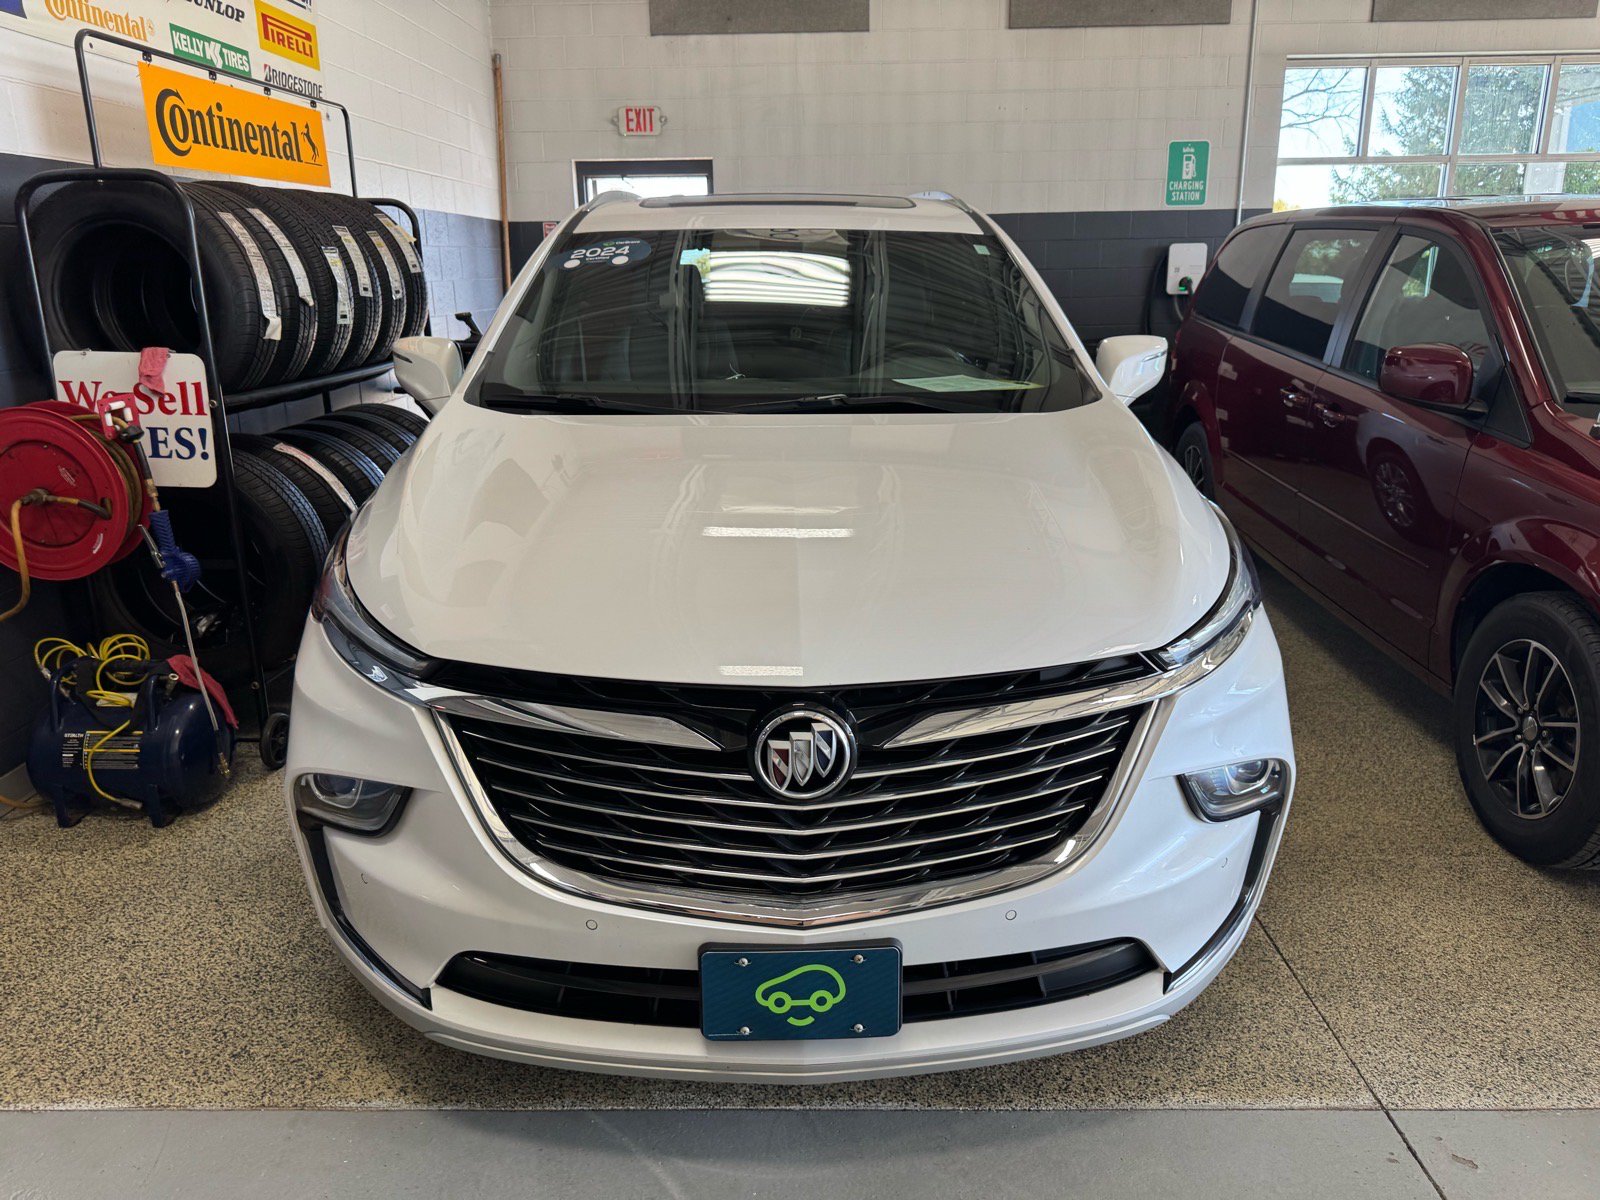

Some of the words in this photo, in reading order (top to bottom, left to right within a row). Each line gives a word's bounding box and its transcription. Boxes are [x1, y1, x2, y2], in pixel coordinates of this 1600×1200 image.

[185, 0, 245, 23] UNLOP
[261, 12, 313, 58] PIRELLI
[172, 31, 204, 57] KELLY
[222, 48, 249, 72] TIRES
[264, 63, 322, 99] BRIDGESTONE
[156, 88, 303, 163] Continental
[625, 108, 655, 133] EXIT
[1169, 181, 1204, 190] CHARGING
[1171, 191, 1200, 201] STATION
[570, 245, 630, 259] 2024
[133, 381, 208, 416] Sell
